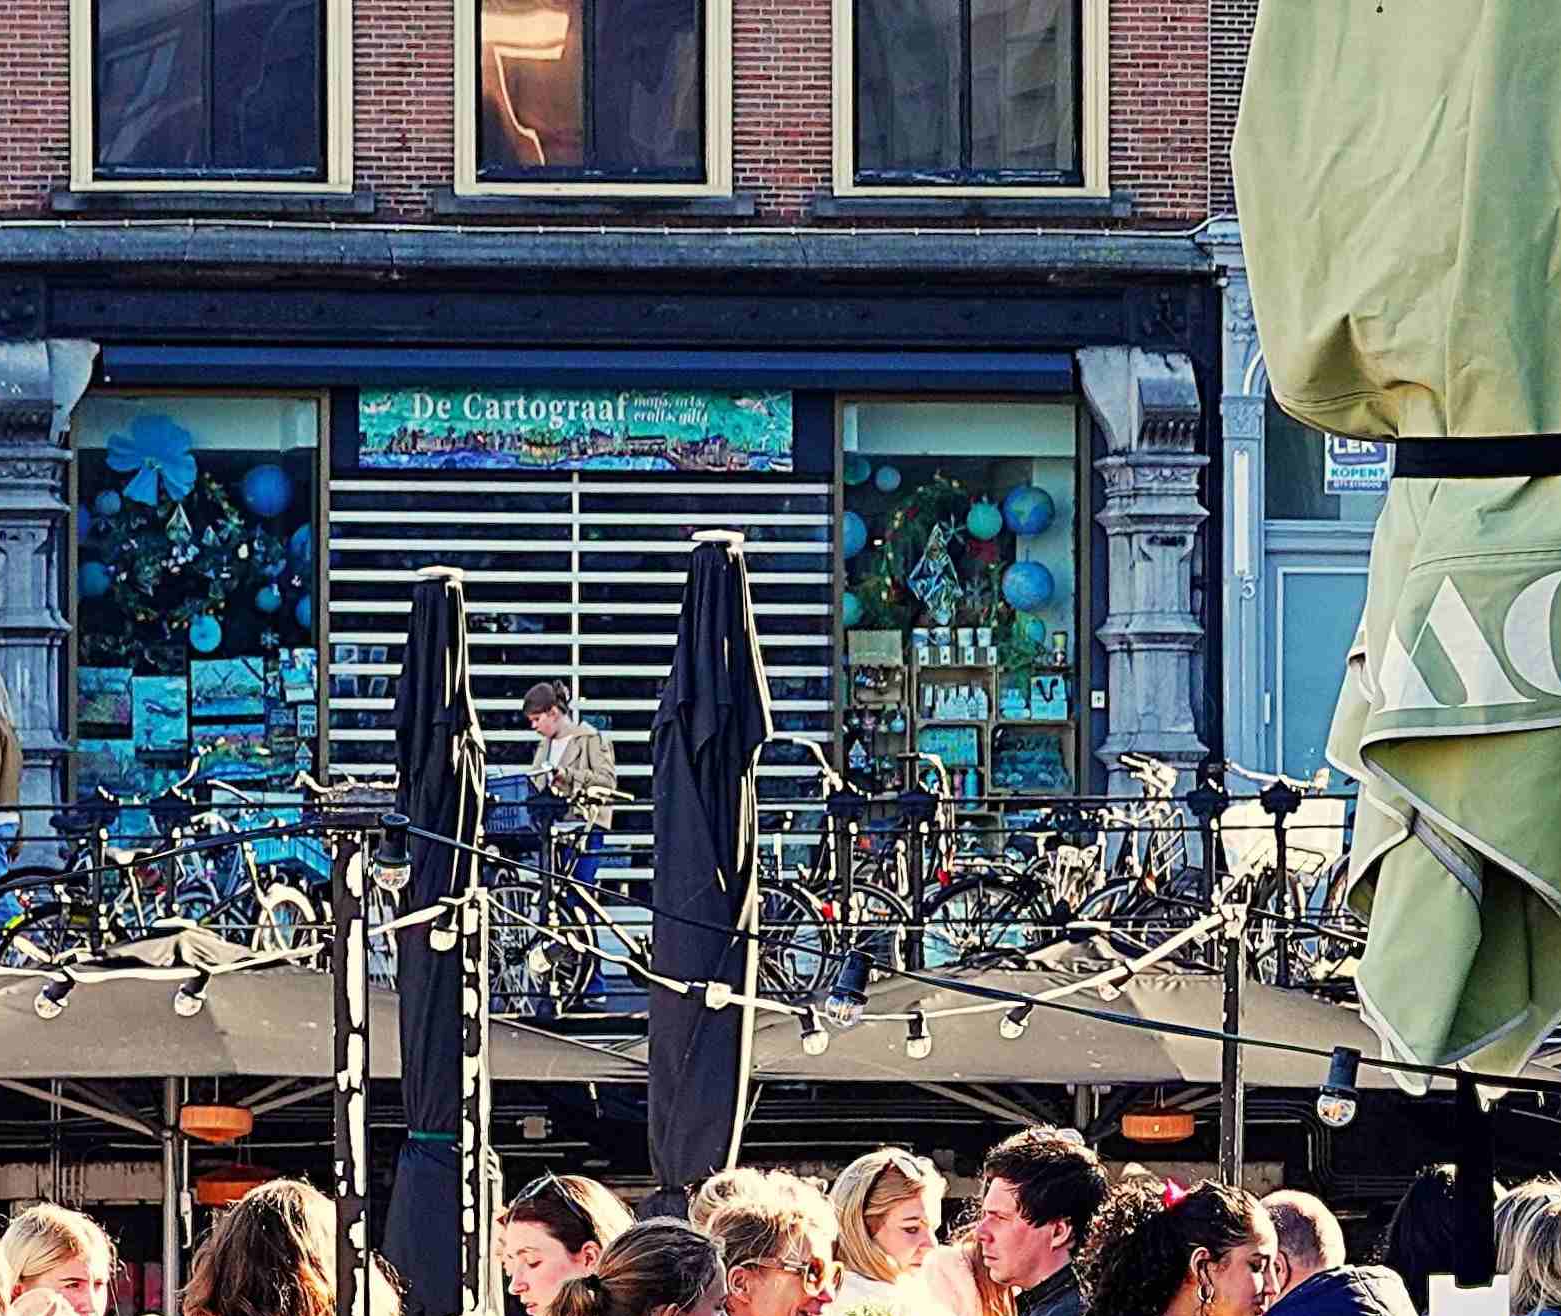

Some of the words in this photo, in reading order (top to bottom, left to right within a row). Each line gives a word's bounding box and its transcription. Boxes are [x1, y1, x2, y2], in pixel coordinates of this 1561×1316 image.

[414, 393, 452, 420] De
[463, 391, 628, 430] Cartograaf
[1330, 466, 1385, 479] KOPEN?
